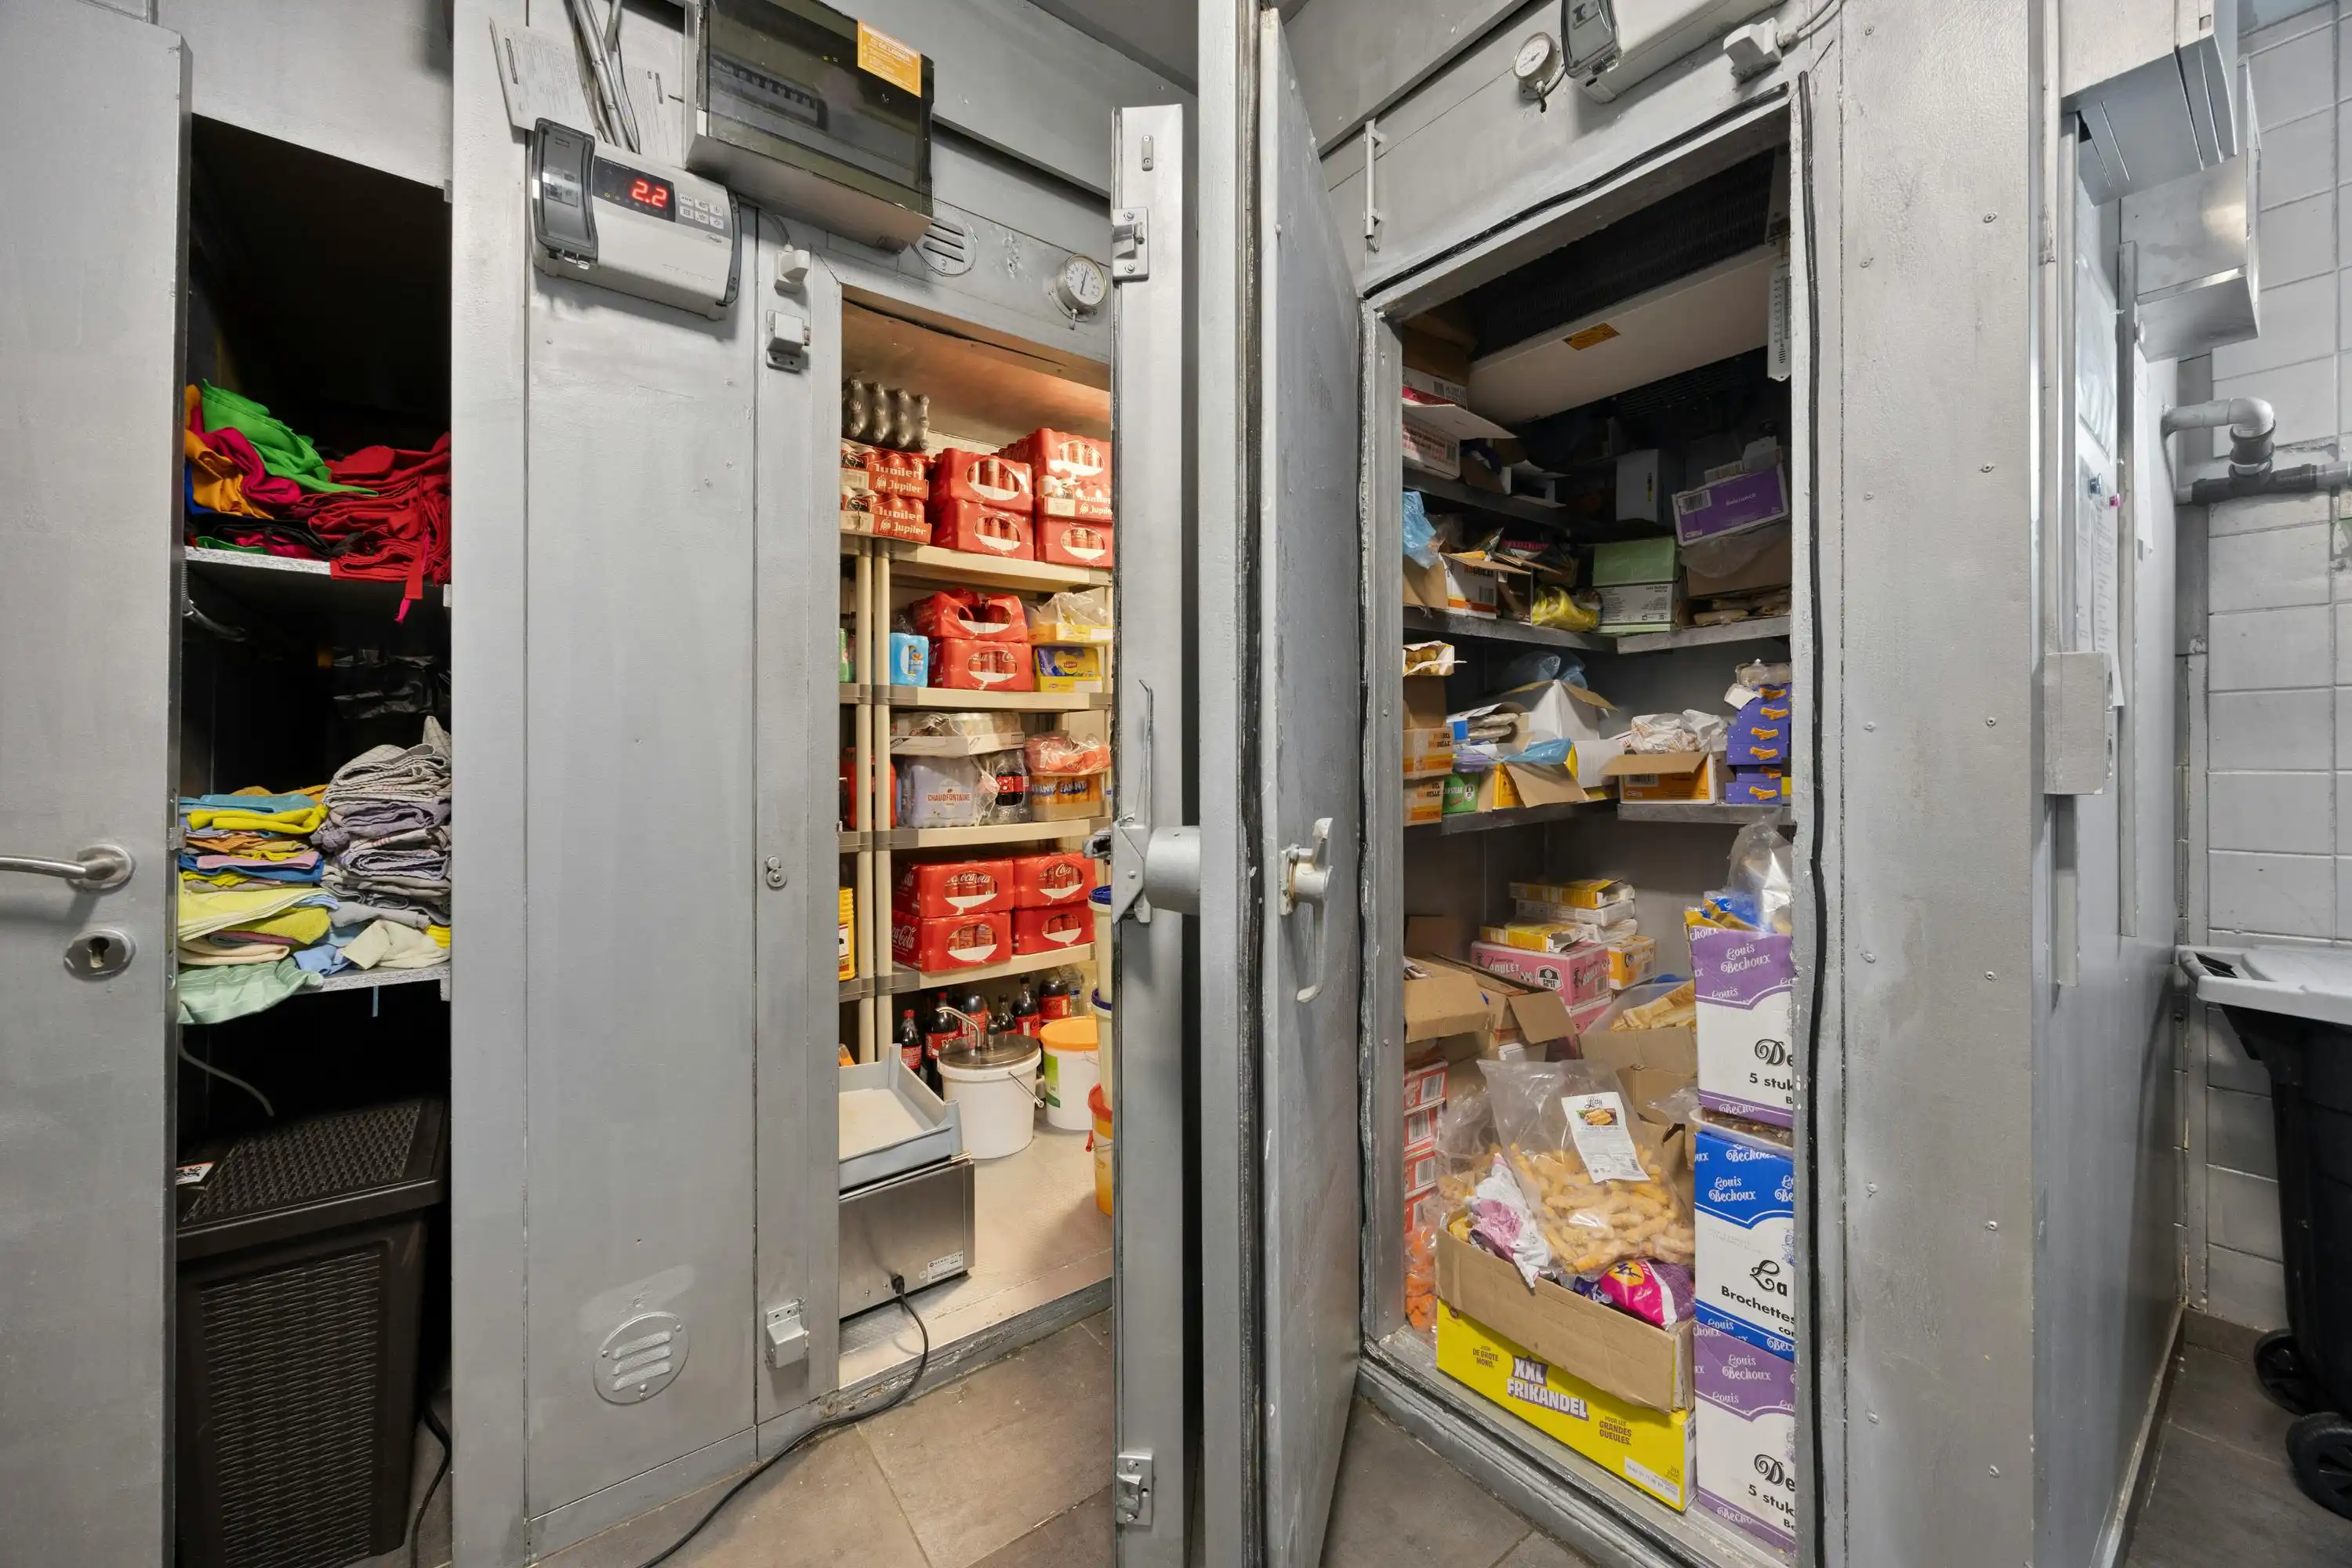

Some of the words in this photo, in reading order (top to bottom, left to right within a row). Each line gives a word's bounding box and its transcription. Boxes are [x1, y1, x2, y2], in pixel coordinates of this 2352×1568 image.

[632, 179, 668, 208] 2.2
[887, 480, 923, 492] Jupiler
[892, 521, 927, 535] Jupiler
[927, 793, 971, 802] CHAUDFONTAINE
[1726, 943, 1755, 960] Louis
[1721, 954, 1771, 973] Bechoux
[1711, 988, 1738, 1000] Louis
[1749, 1073, 1758, 1083] 5
[1715, 1176, 1741, 1190] Louis
[1709, 1189, 1756, 1202] Bechoux
[1750, 1259, 1788, 1297] La
[1480, 1350, 1499, 1362] GROTE
[1729, 1354, 1756, 1368] Louis
[1514, 1357, 1544, 1385] XXL
[1722, 1366, 1772, 1381] Bechoux
[1507, 1377, 1587, 1418] FRIKANDEL
[1599, 1421, 1632, 1437] GRANDES
[1748, 1483, 1757, 1497] 5
